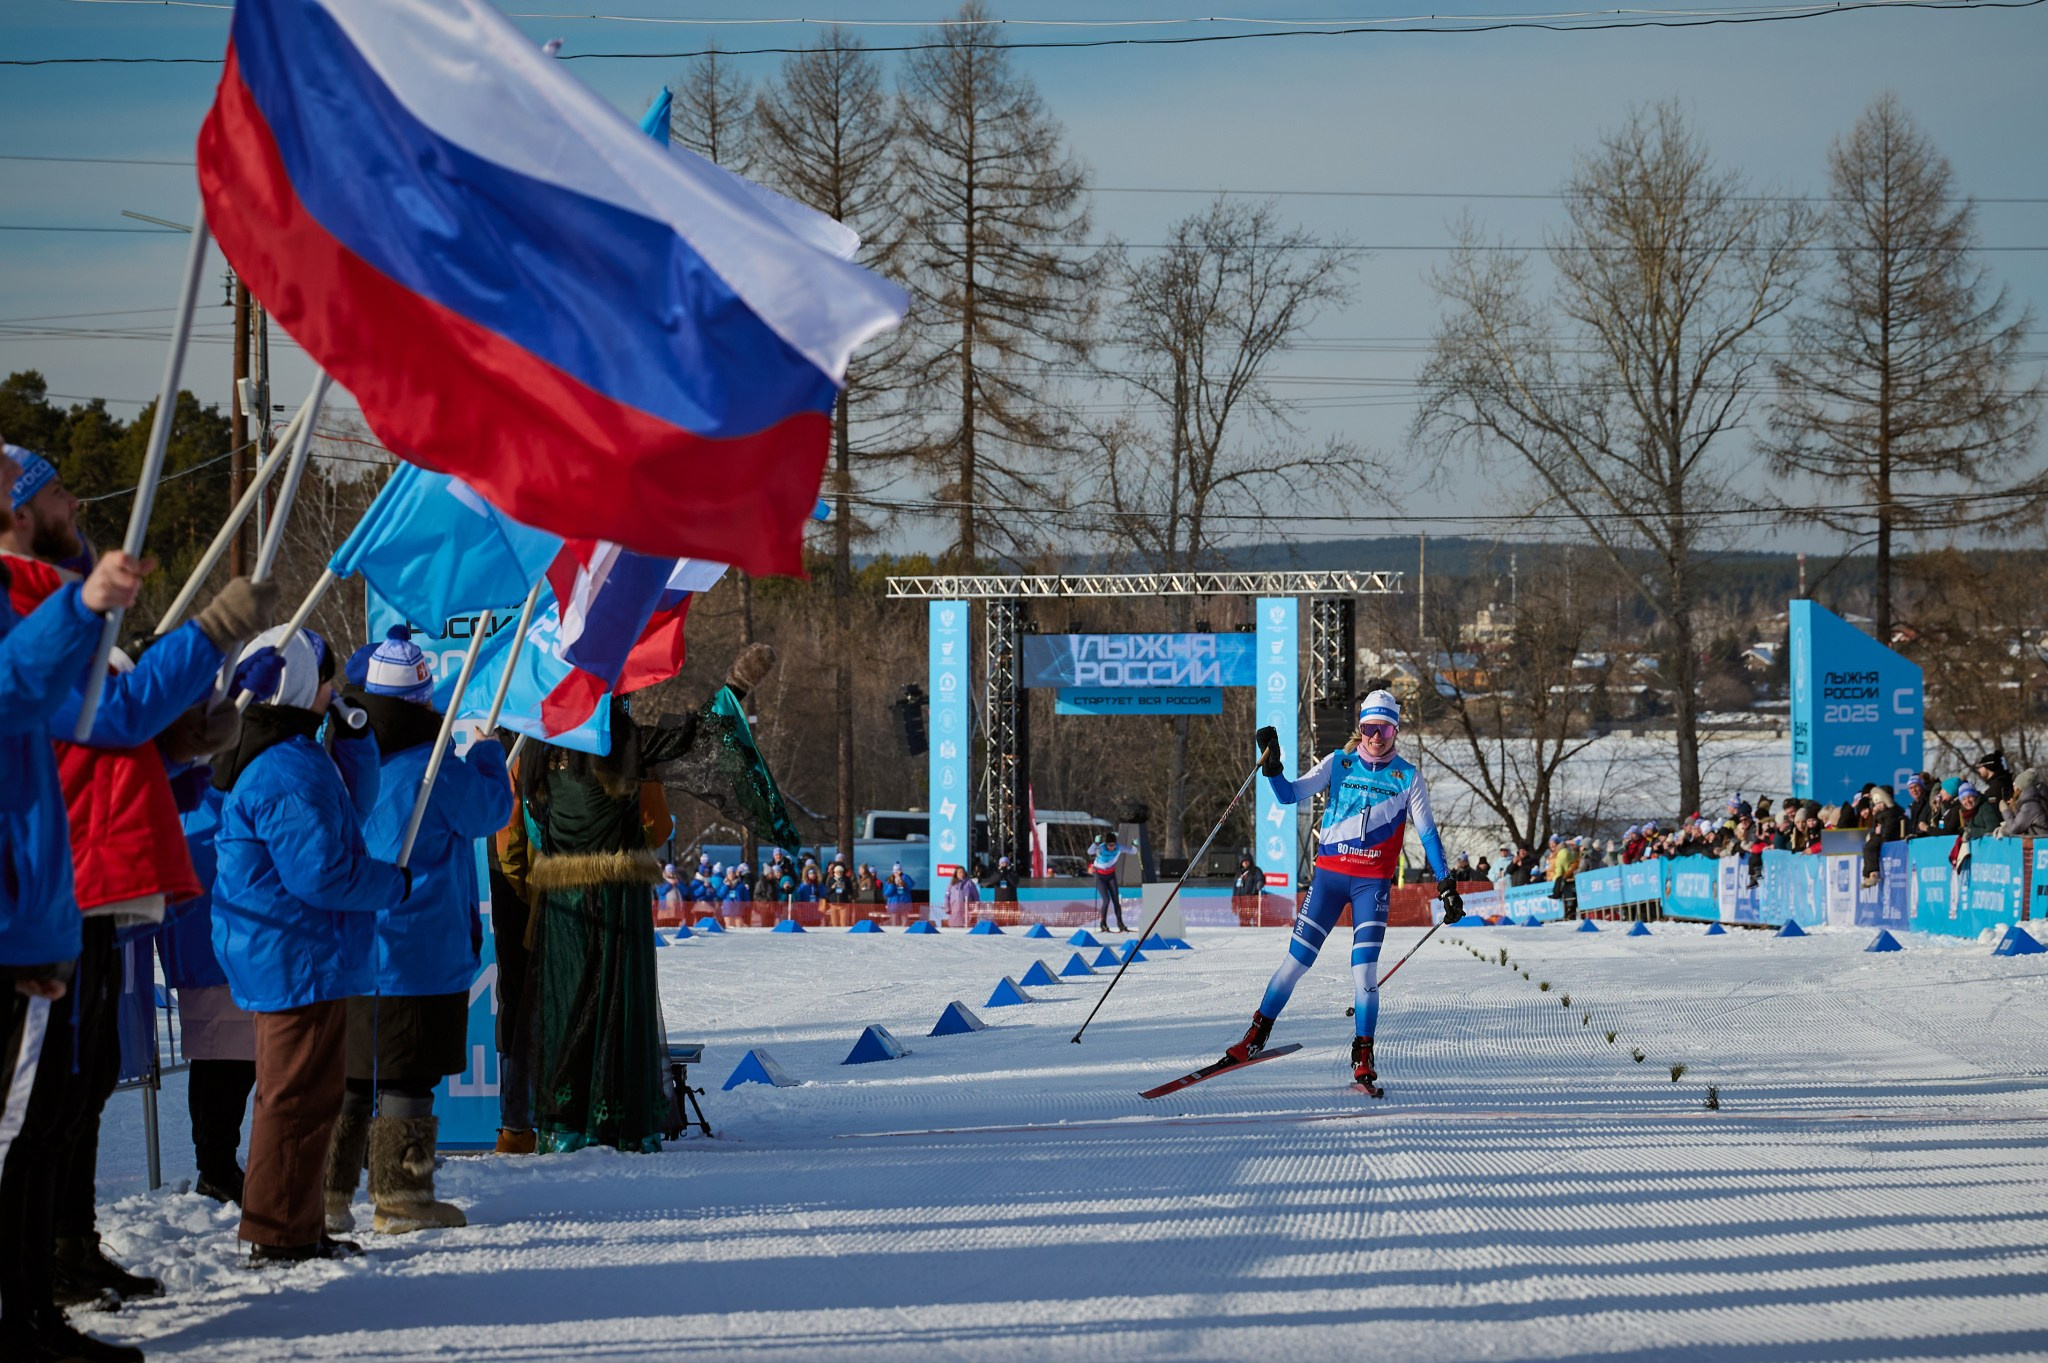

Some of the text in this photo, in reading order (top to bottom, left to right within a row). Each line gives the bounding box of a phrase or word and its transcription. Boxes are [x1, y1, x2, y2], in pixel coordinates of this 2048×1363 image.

[1078, 633, 1217, 660] ЛЫЖНЯ
[1074, 661, 1221, 687] РОССИИ
[1824, 671, 1879, 685] ЛЫЖНЯ
[1073, 696, 1212, 706] СТАРТУЕТ ВСЯ РОССИЯ
[1823, 687, 1879, 700] РОССИИ
[1823, 704, 1880, 723] 2025
[1360, 804, 1372, 842] 1
[1337, 843, 1348, 855] 80
[1295, 919, 1305, 936] SKI
